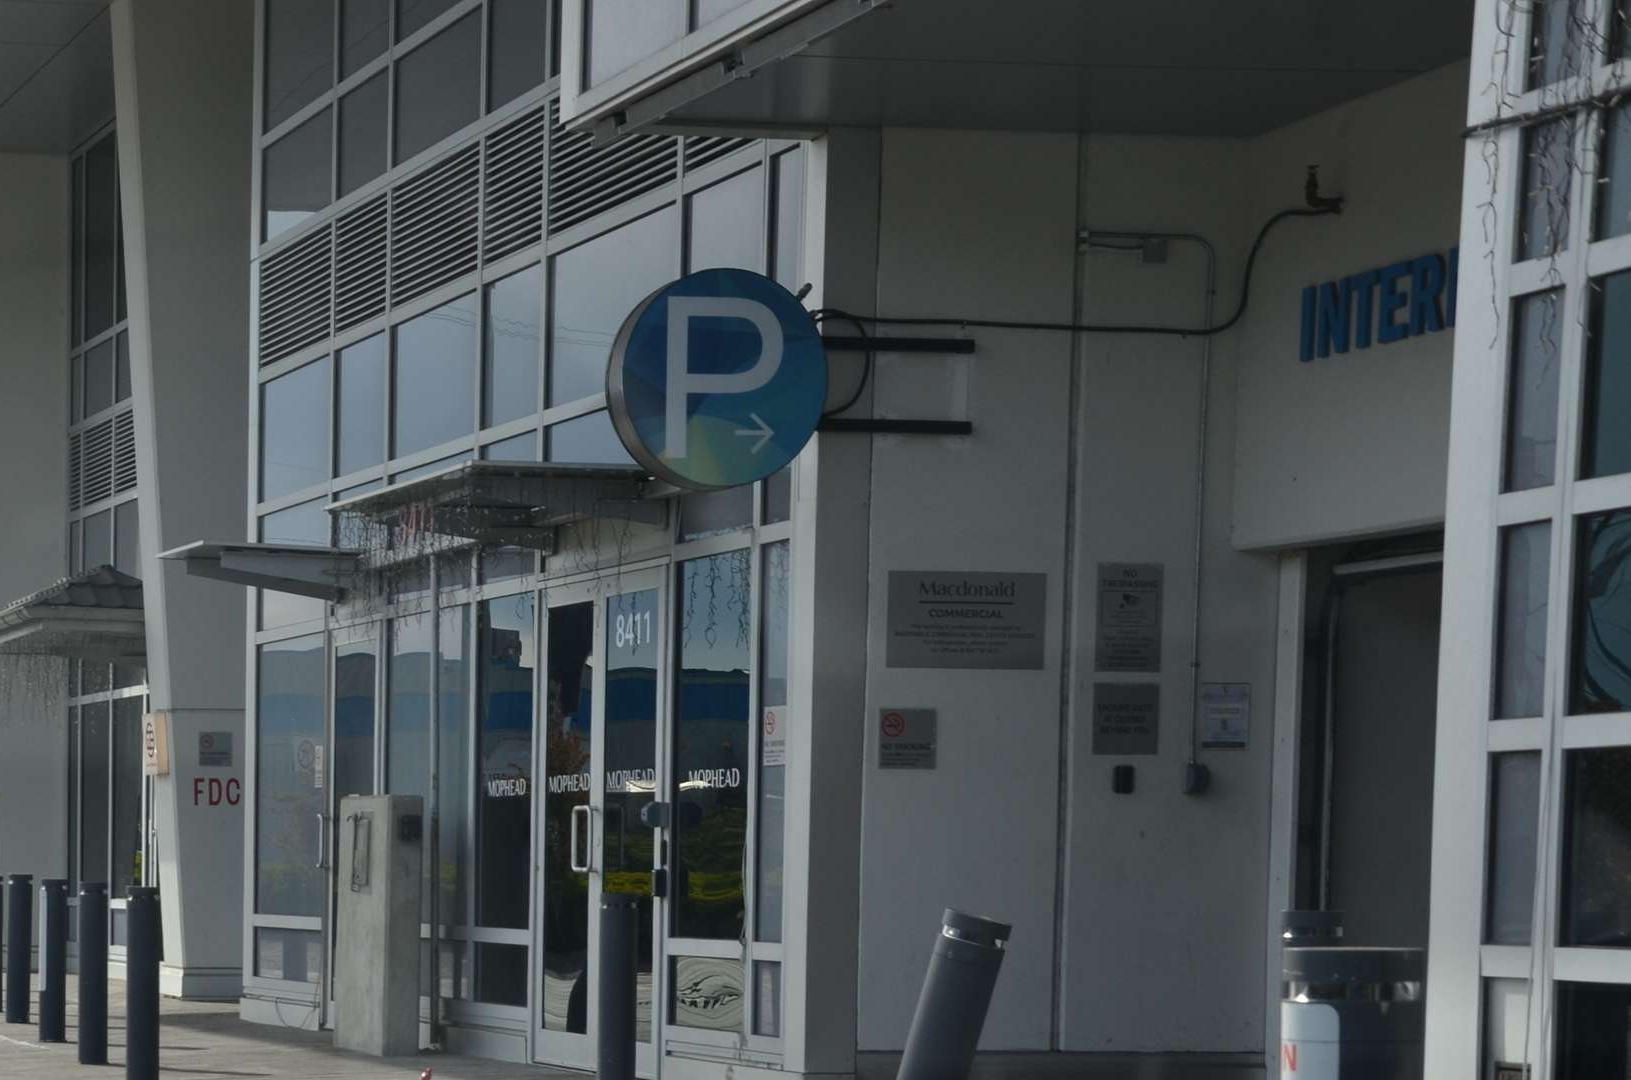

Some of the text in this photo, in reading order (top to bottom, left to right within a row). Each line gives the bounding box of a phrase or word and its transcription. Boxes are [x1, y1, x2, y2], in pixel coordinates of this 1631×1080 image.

[1299, 246, 1460, 362] INTER
[665, 295, 785, 459] P
[1122, 568, 1138, 578] NO
[919, 580, 1016, 598] Macdonald
[928, 608, 1004, 618] COMMERCIAL
[614, 609, 652, 650] 8411
[487, 778, 527, 798] MOPHEAD
[549, 772, 591, 793] MOPHEAD
[688, 767, 741, 789] MOPHEAD
[193, 777, 241, 806] FDC
